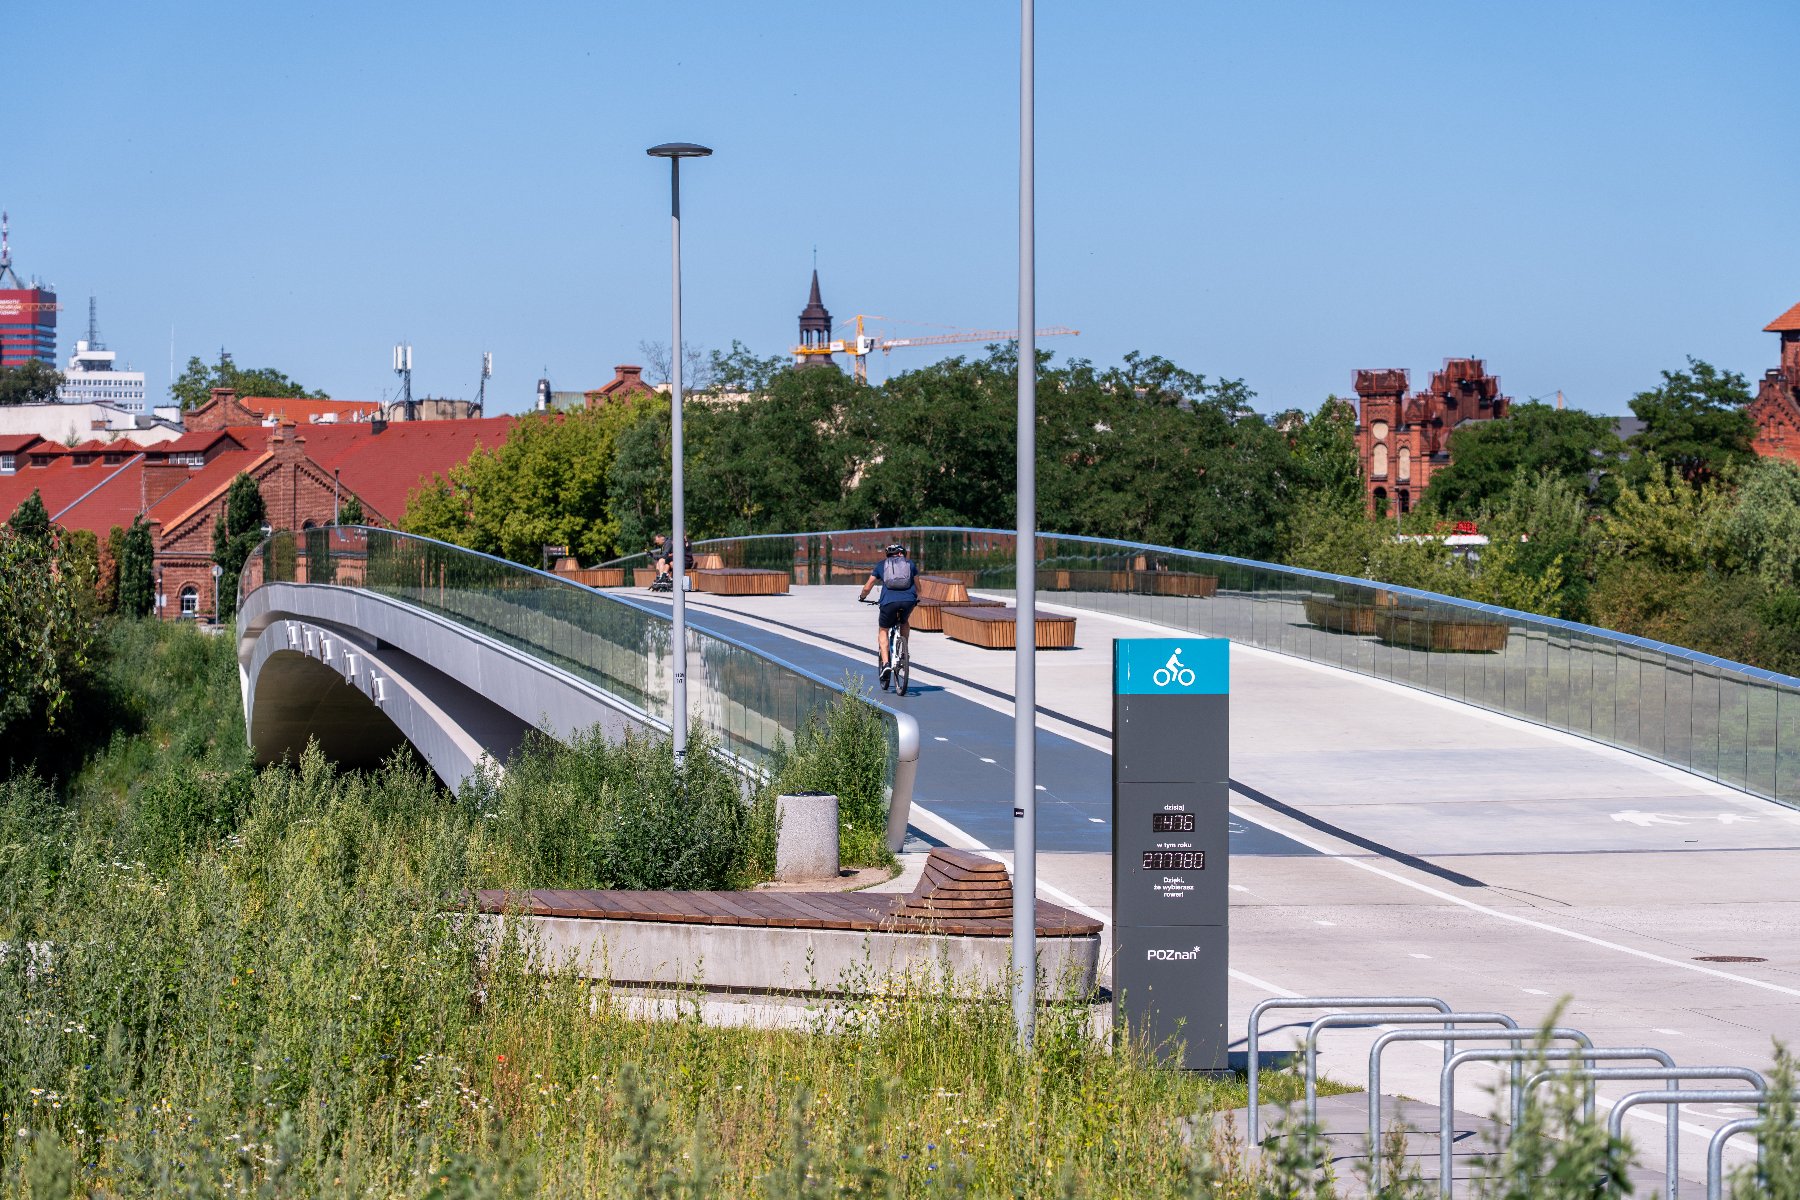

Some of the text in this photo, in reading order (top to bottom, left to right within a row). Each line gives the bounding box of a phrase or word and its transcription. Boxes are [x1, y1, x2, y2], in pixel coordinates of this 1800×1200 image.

[1164, 804, 1185, 812] dzisiaj
[1163, 815, 1194, 831] 476
[1143, 853, 1204, 869] 277780
